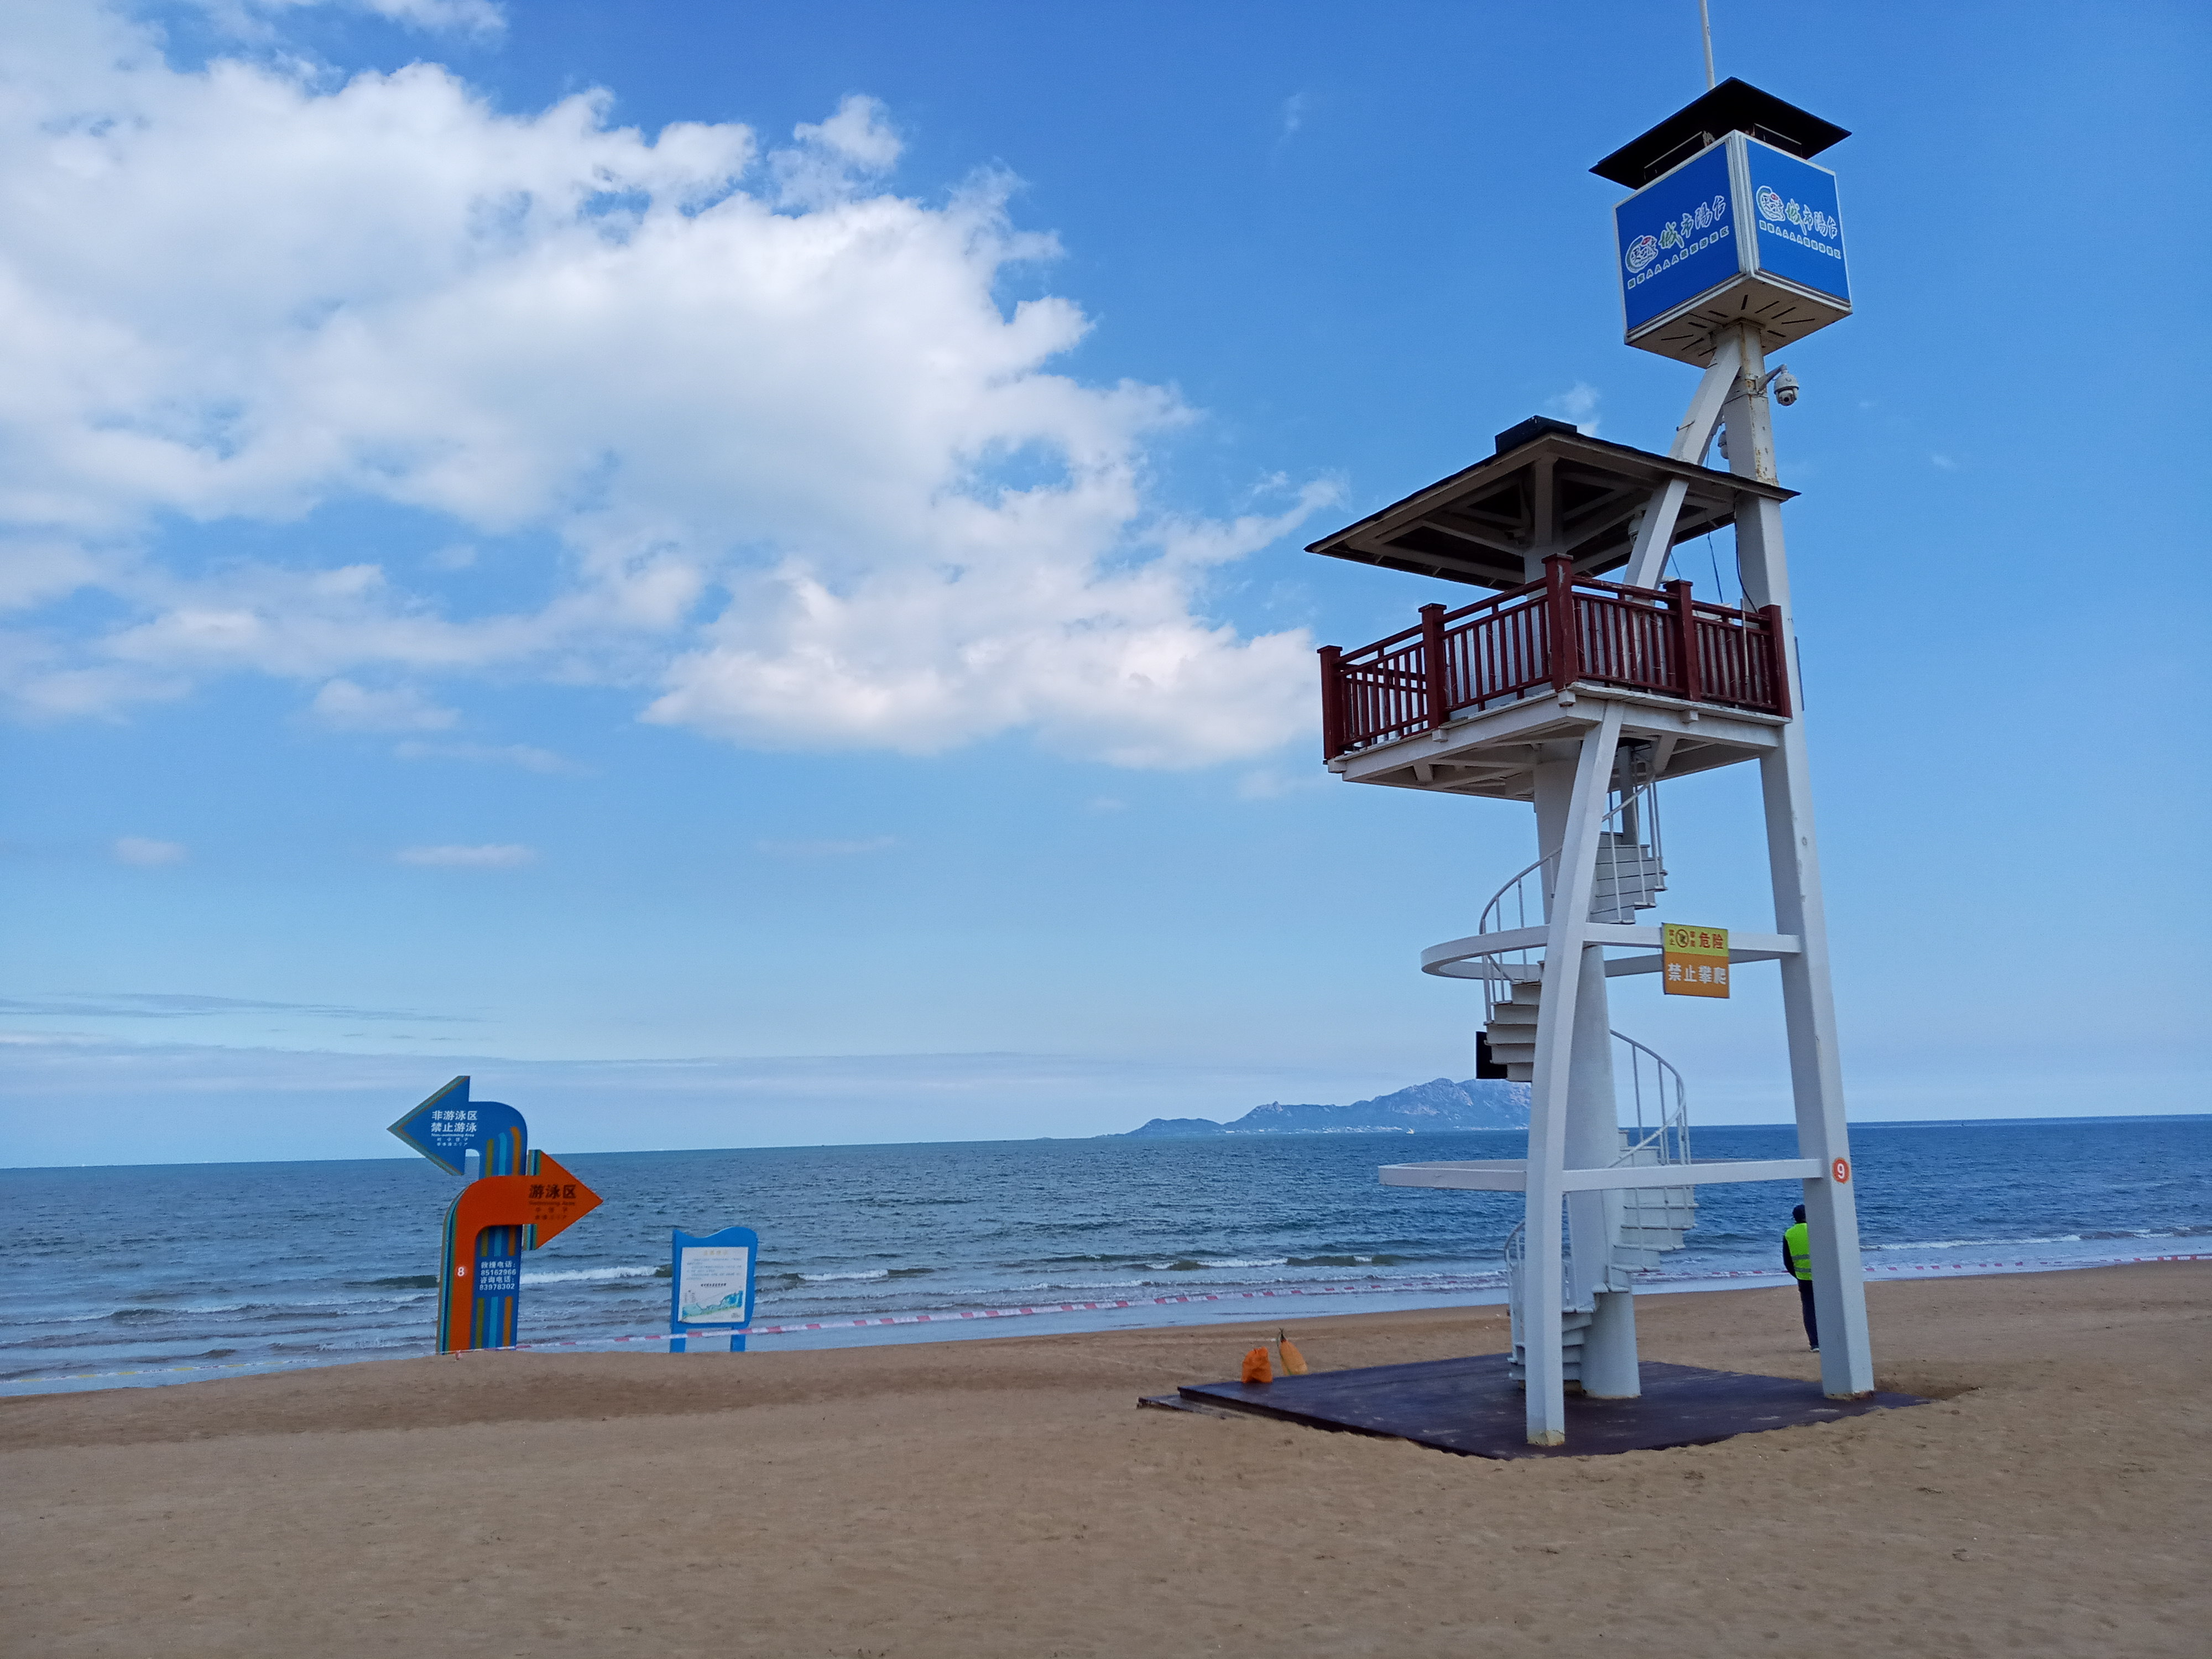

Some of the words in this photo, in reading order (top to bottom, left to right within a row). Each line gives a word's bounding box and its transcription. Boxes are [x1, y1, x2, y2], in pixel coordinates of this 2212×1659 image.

[1699, 932, 1724, 950] 危险
[1668, 962, 1726, 985] 禁止攀爬
[431, 1110, 478, 1121] 非游泳区
[431, 1122, 477, 1133] 禁止游泳
[1837, 1163, 1845, 1179] 9
[529, 1185, 576, 1199] 游泳区
[457, 1266, 465, 1277] 8
